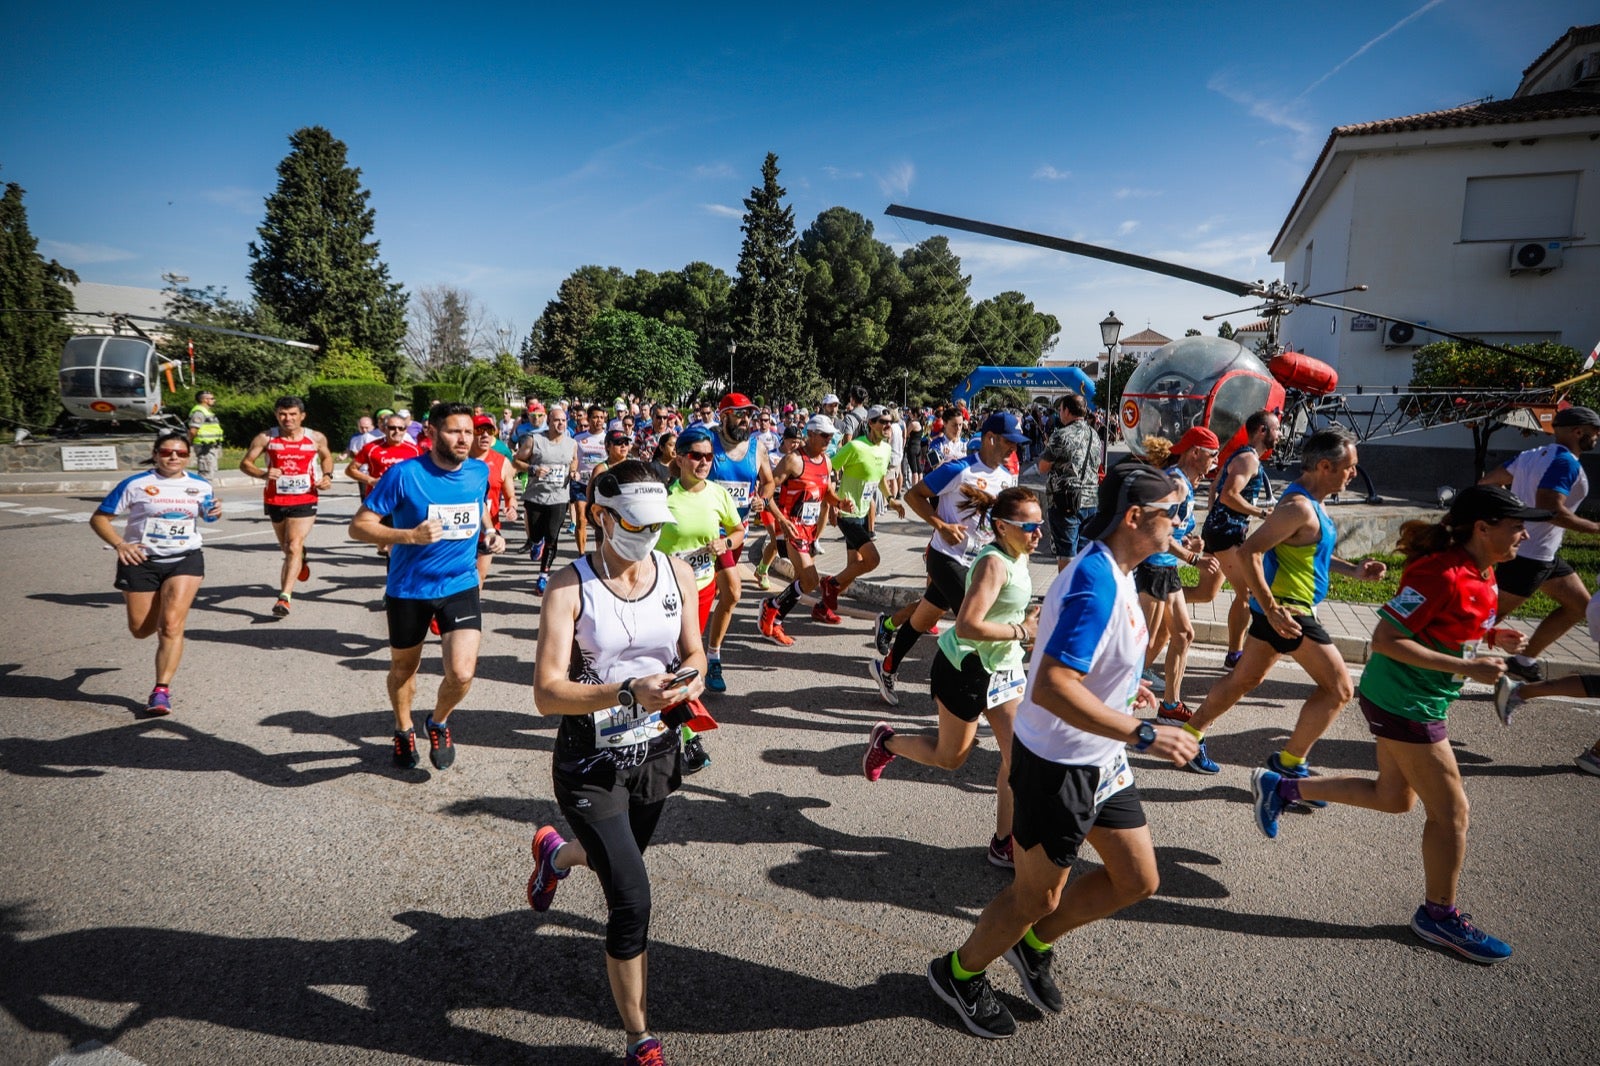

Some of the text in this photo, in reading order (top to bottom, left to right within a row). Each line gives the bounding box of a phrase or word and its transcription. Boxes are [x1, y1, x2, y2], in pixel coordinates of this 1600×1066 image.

[289, 479, 307, 487] 255
[727, 487, 745, 497] 220
[453, 511, 470, 525] 58
[169, 525, 185, 536] 54
[689, 552, 710, 567] 296
